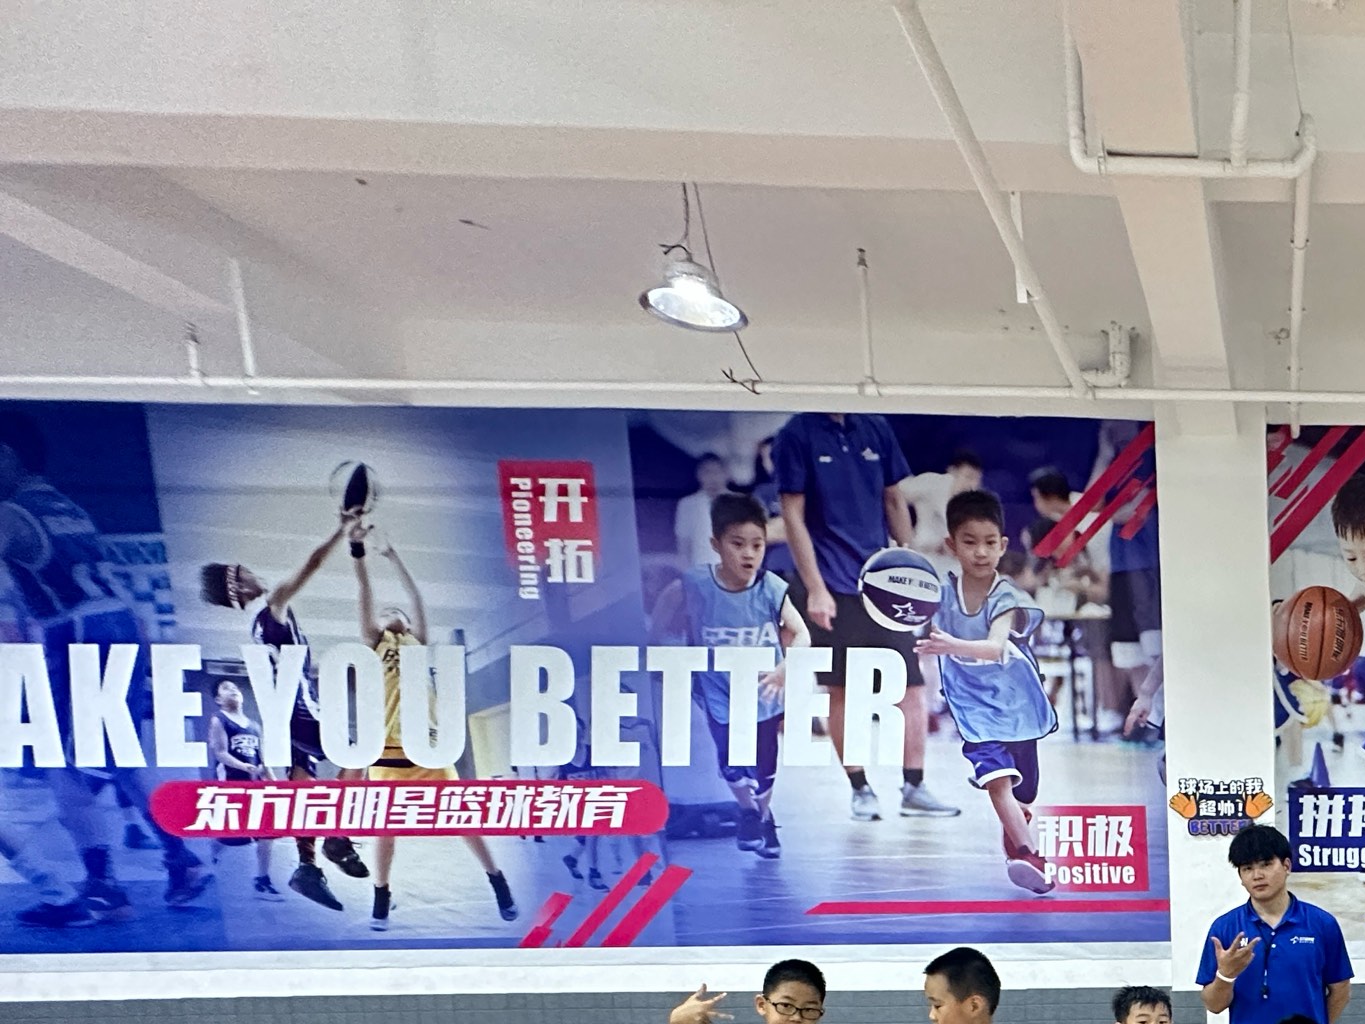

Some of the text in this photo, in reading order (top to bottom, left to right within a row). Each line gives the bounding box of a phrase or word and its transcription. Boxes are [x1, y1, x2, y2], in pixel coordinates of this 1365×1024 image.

[510, 478, 541, 600] Pioneering
[538, 478, 595, 583] 开拓
[241, 642, 467, 770] YOU
[509, 644, 909, 769] BETTER
[183, 785, 643, 833] 东方启明星篮球教育
[1179, 778, 1264, 795] 球场上的我
[1037, 815, 1134, 857] 积极
[1044, 862, 1136, 885] Positive
